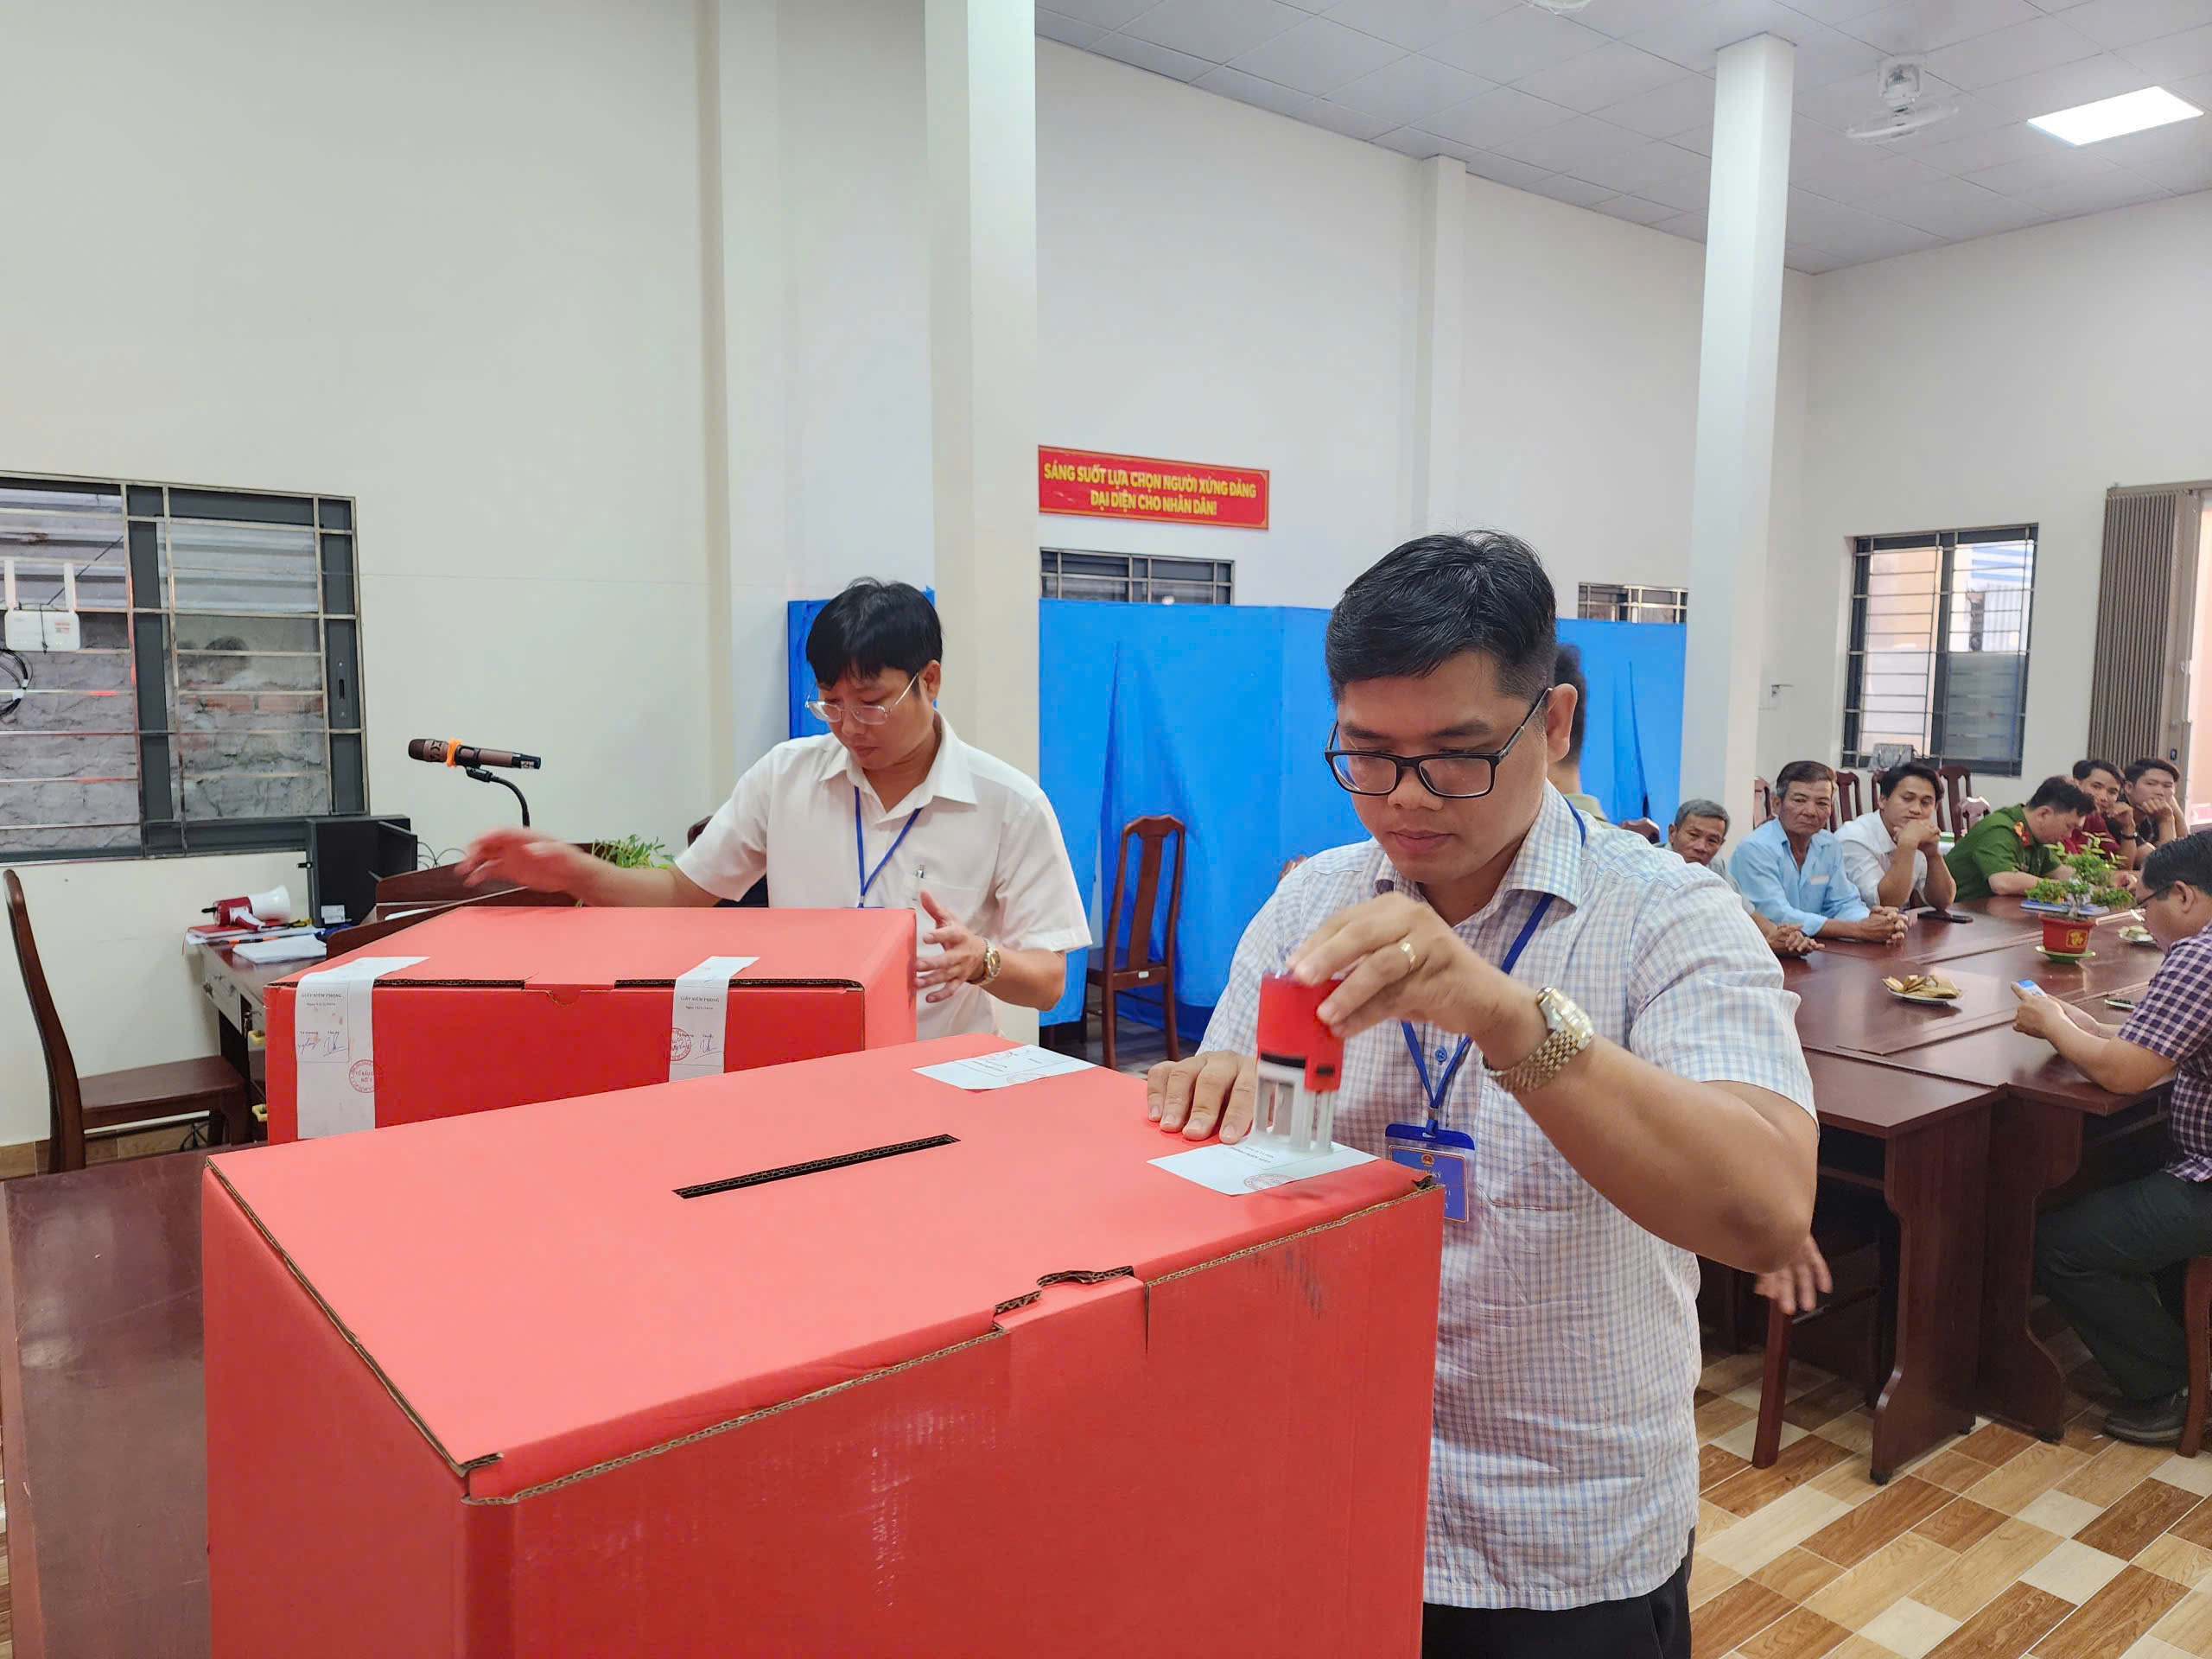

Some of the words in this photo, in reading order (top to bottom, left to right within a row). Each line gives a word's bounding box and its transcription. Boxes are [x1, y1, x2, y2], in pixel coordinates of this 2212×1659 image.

[1044, 459, 1076, 481] SÁNG
[1077, 463, 1106, 484] SUỐT
[1108, 468, 1128, 490] LỰA
[1130, 472, 1161, 493] CHỌN
[1163, 474, 1198, 493] NGƯỜI
[1198, 475, 1228, 495] XỨNG
[1230, 478, 1256, 498] ĐÁNG
[1090, 489, 1109, 511] ĐẠI
[1111, 489, 1136, 512] DIỆN
[1138, 493, 1161, 512] CHO
[1162, 493, 1192, 513] NHÂN
